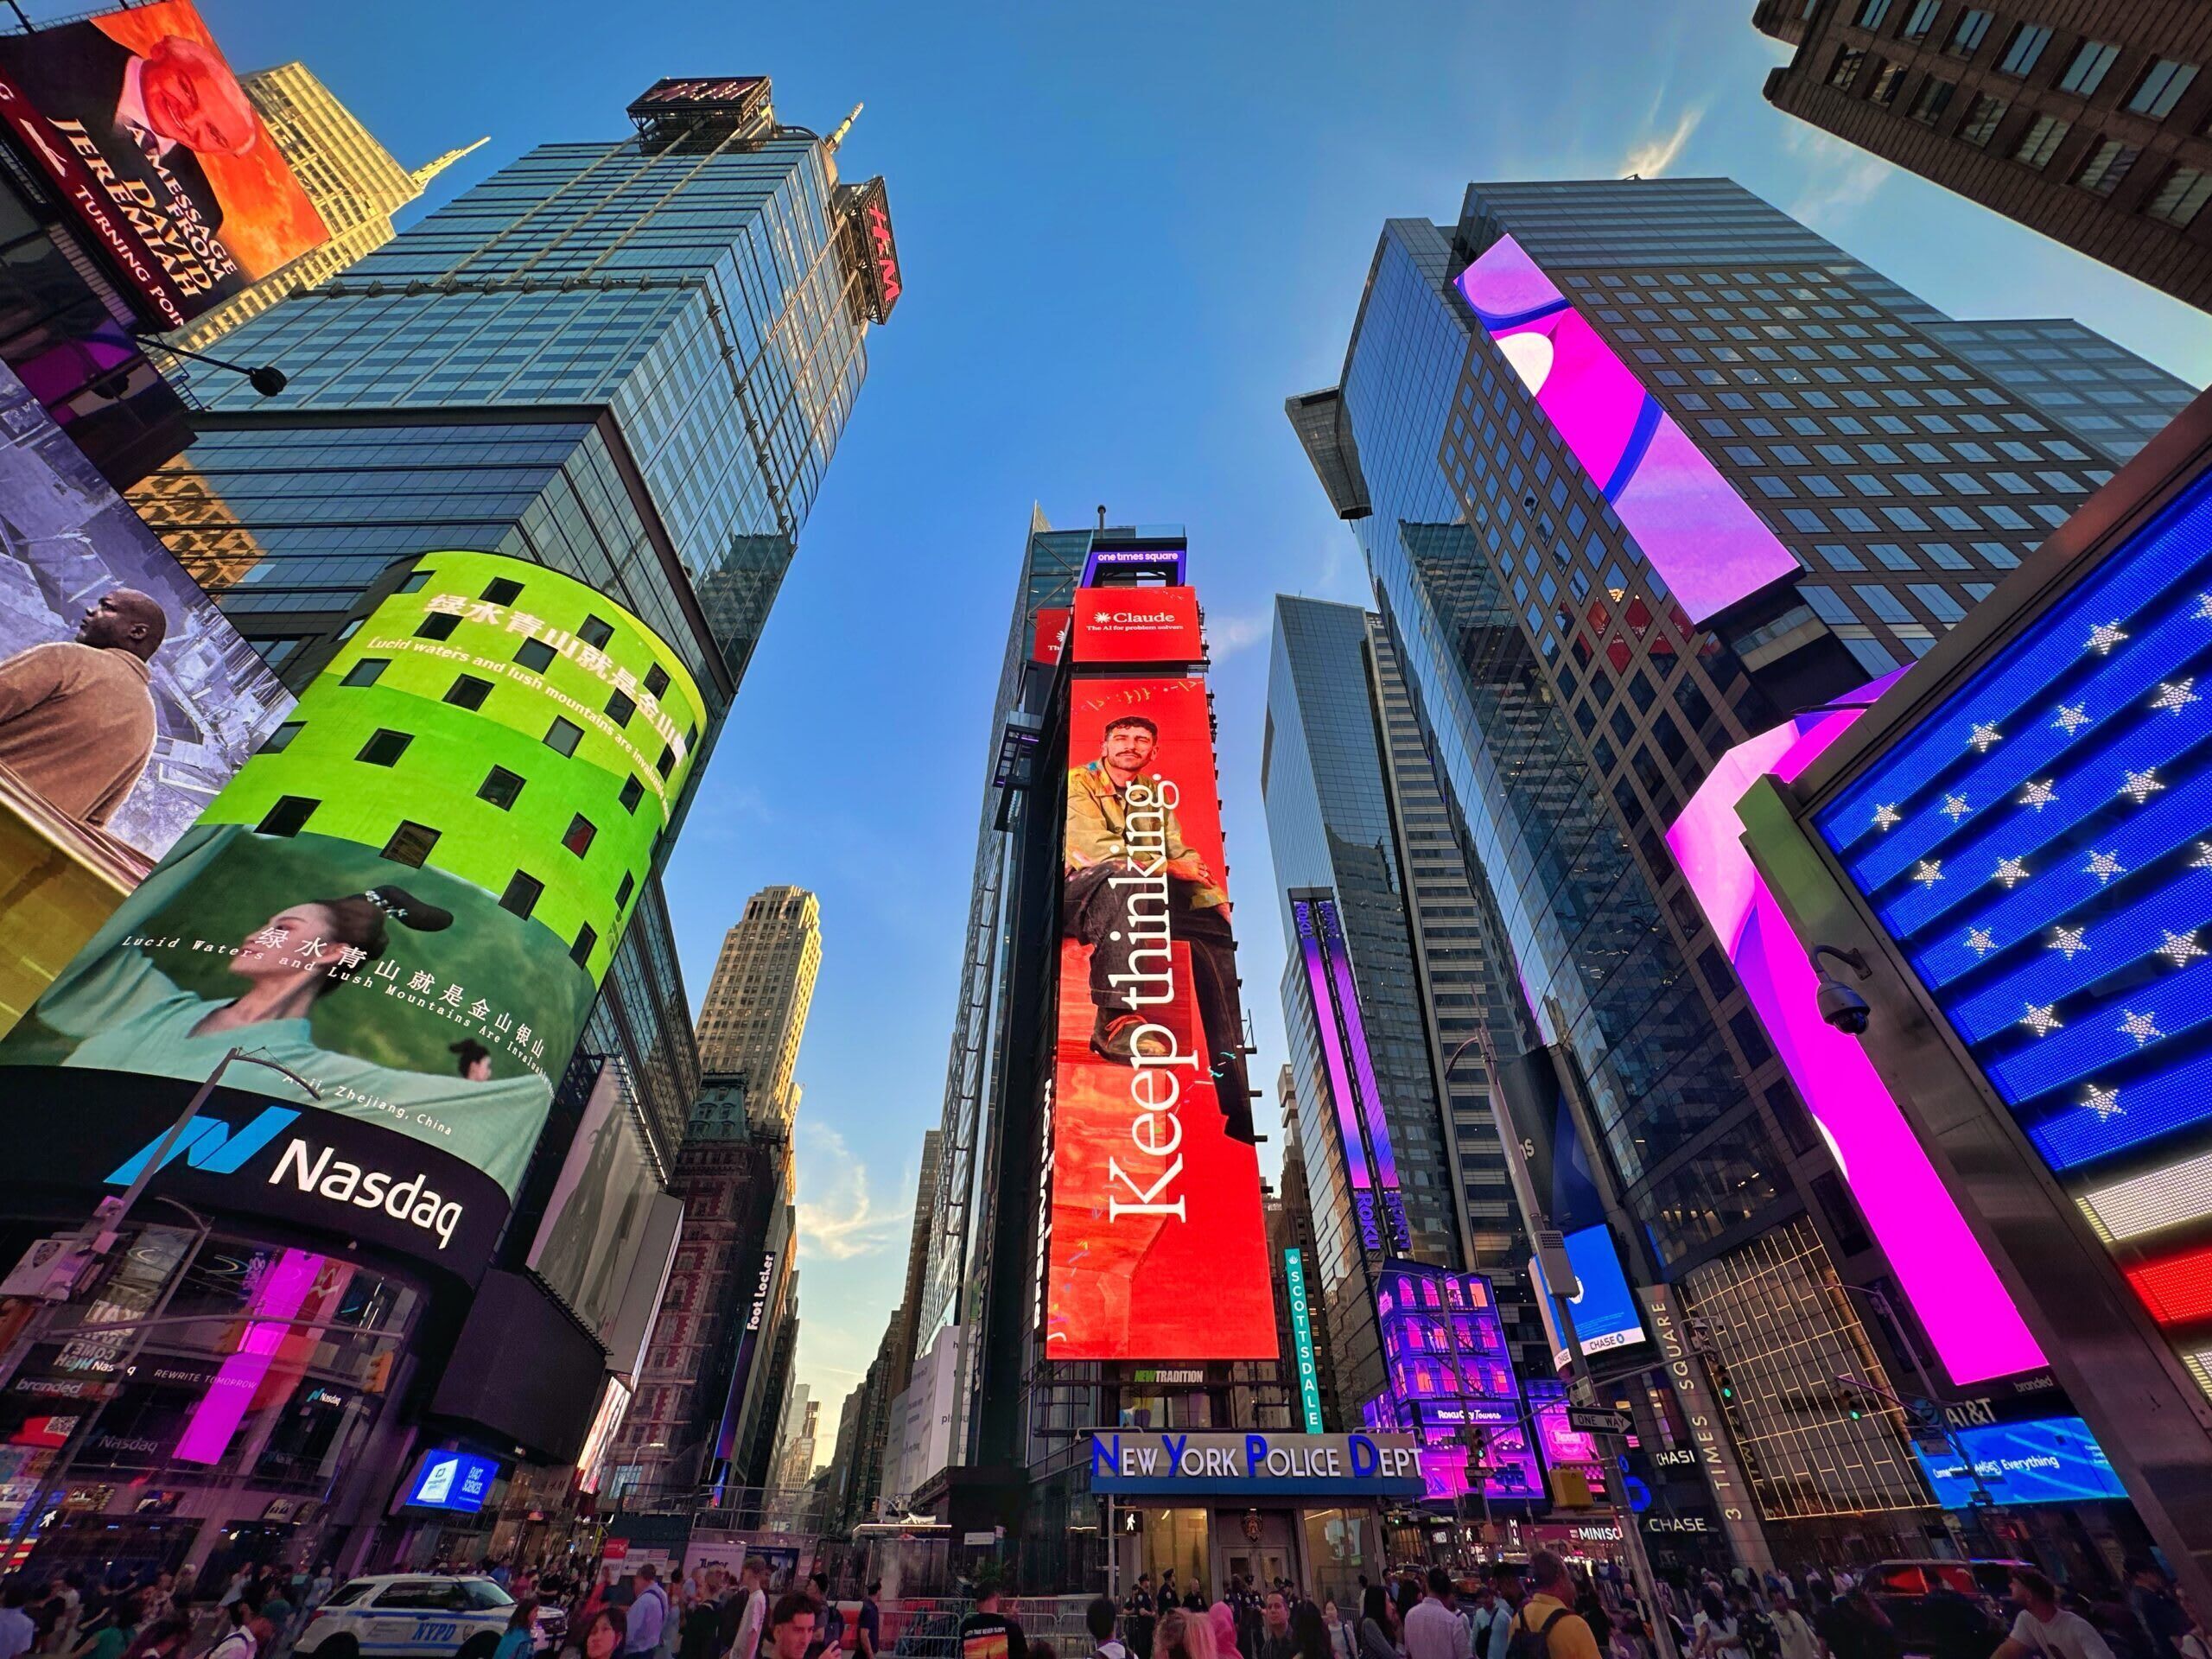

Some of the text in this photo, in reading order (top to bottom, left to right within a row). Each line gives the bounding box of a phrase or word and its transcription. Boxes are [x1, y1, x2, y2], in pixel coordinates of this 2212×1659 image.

[46, 117, 203, 298] JEREMIAH
[125, 124, 238, 275] A MESSAGE
[74, 184, 151, 283] TURNING
[121, 178, 213, 290] DAVID
[165, 203, 227, 283] FROM
[1117, 552, 1144, 561] times
[1145, 552, 1179, 563] square
[1113, 612, 1175, 623] Claude
[367, 636, 413, 650] Lucid
[414, 642, 470, 662] waters
[473, 656, 506, 673] and
[507, 668, 544, 690] lush
[544, 685, 614, 736] mountains
[614, 734, 632, 753] are
[122, 936, 180, 948] Lucid
[192, 940, 264, 960] Waters
[278, 957, 316, 972] and
[327, 966, 374, 988] Lush
[385, 984, 471, 1027] Mountains
[479, 1026, 501, 1043] Are
[255, 927, 545, 1059] 绿水青山就是金山银山
[1107, 773, 1198, 1224] Keep thinking.
[334, 1086, 410, 1120] Zhejiang,
[416, 1113, 453, 1136] China
[269, 1138, 463, 1249] Nasdaq
[1355, 1192, 1381, 1249] ROKU
[747, 1255, 774, 1331] Foot Locker
[92, 1361, 137, 1376] Nasq
[1291, 1271, 1318, 1426] SCOTTSDALE
[1589, 1336, 1617, 1351] CHASE
[15, 1378, 84, 1394] branded
[154, 1369, 258, 1389] REWRITE TOMORROW
[320, 1391, 341, 1407] Nasdaq
[2013, 1376, 2054, 1393] branded
[1473, 1409, 1502, 1421] Towers
[1577, 1414, 1625, 1427] ONE WAY
[1651, 1302, 1742, 1521] 3 TIMES SQUARE
[1092, 1434, 1423, 1478] NEW YORK POLICE DEPT
[2000, 1454, 2060, 1473] Everything
[1649, 1517, 1707, 1532] CHASE
[411, 1623, 457, 1642] NYPD
